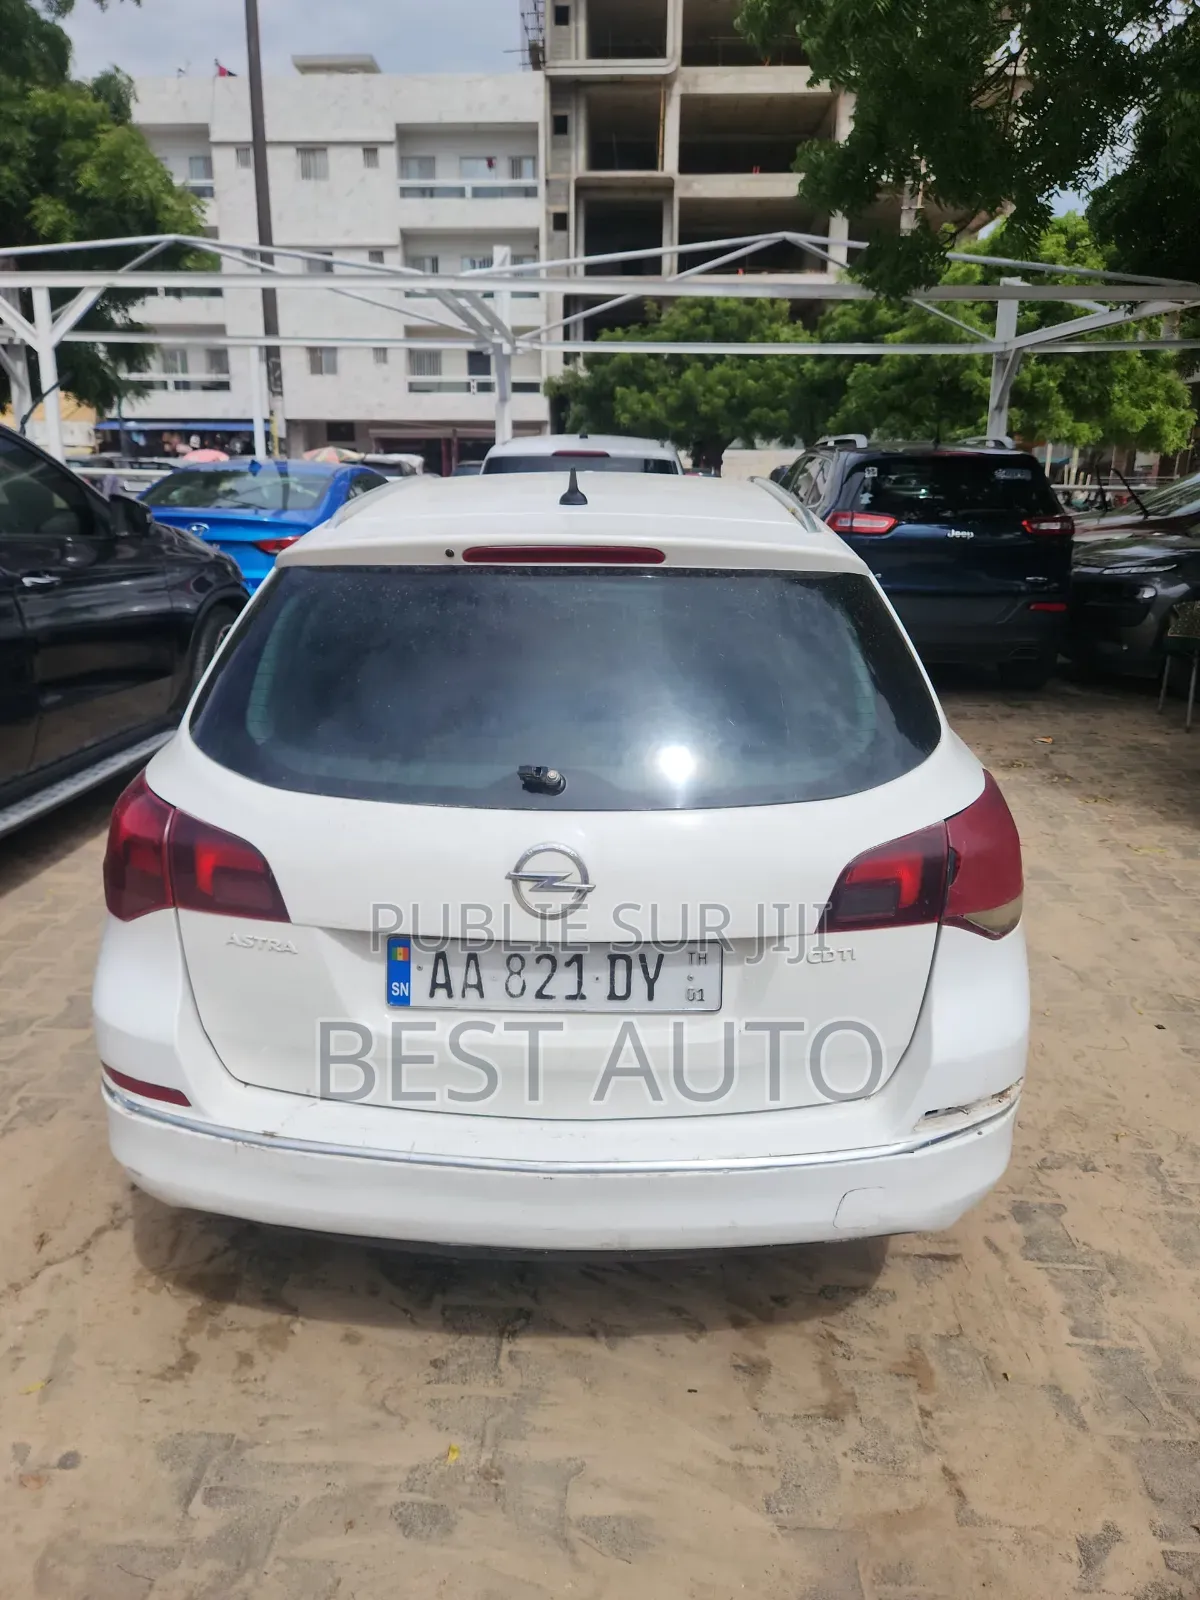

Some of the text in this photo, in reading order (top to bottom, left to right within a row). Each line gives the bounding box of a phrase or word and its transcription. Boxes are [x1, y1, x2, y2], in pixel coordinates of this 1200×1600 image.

[947, 529, 974, 540] Jeep
[226, 932, 298, 954] ASTRA
[687, 952, 708, 965] TH
[428, 951, 665, 1001] AA 821 DY
[391, 982, 409, 997] SN
